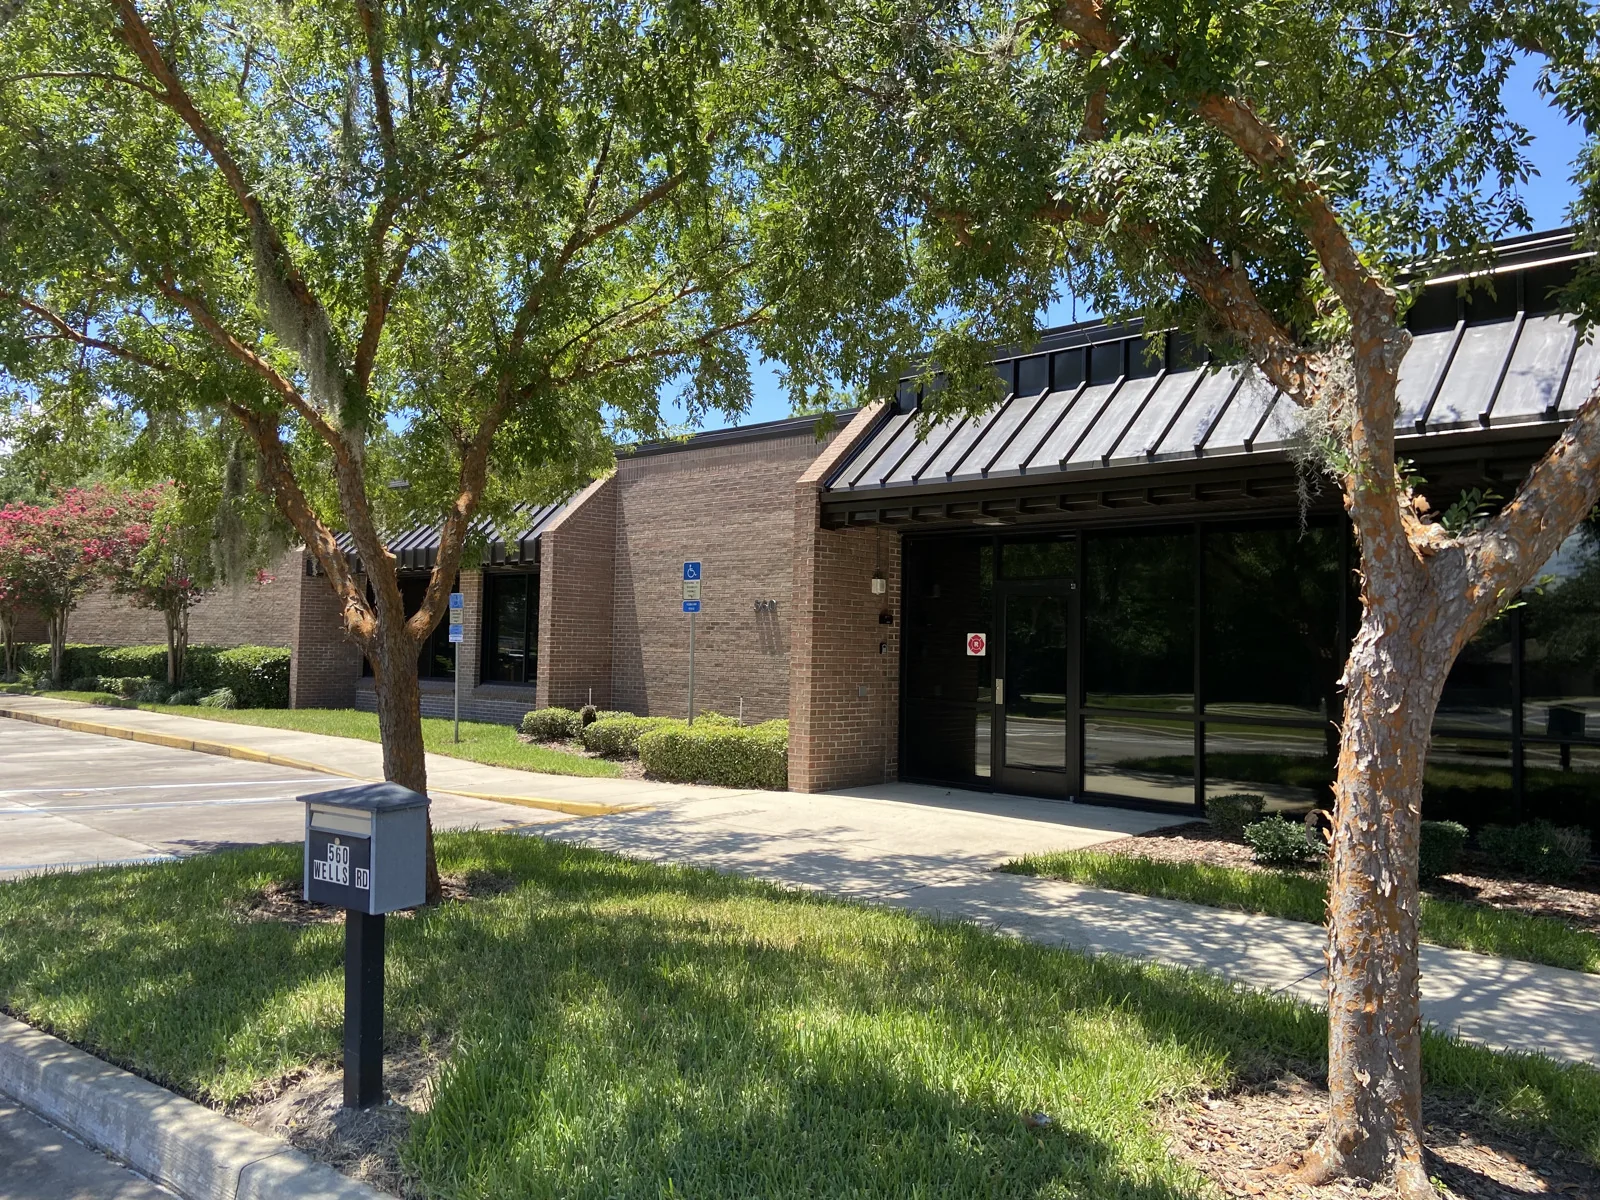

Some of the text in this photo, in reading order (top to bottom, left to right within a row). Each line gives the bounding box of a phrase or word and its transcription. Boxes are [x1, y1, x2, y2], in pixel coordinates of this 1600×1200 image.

[328, 844, 348, 865] 560
[314, 861, 368, 888] WELLS RD
